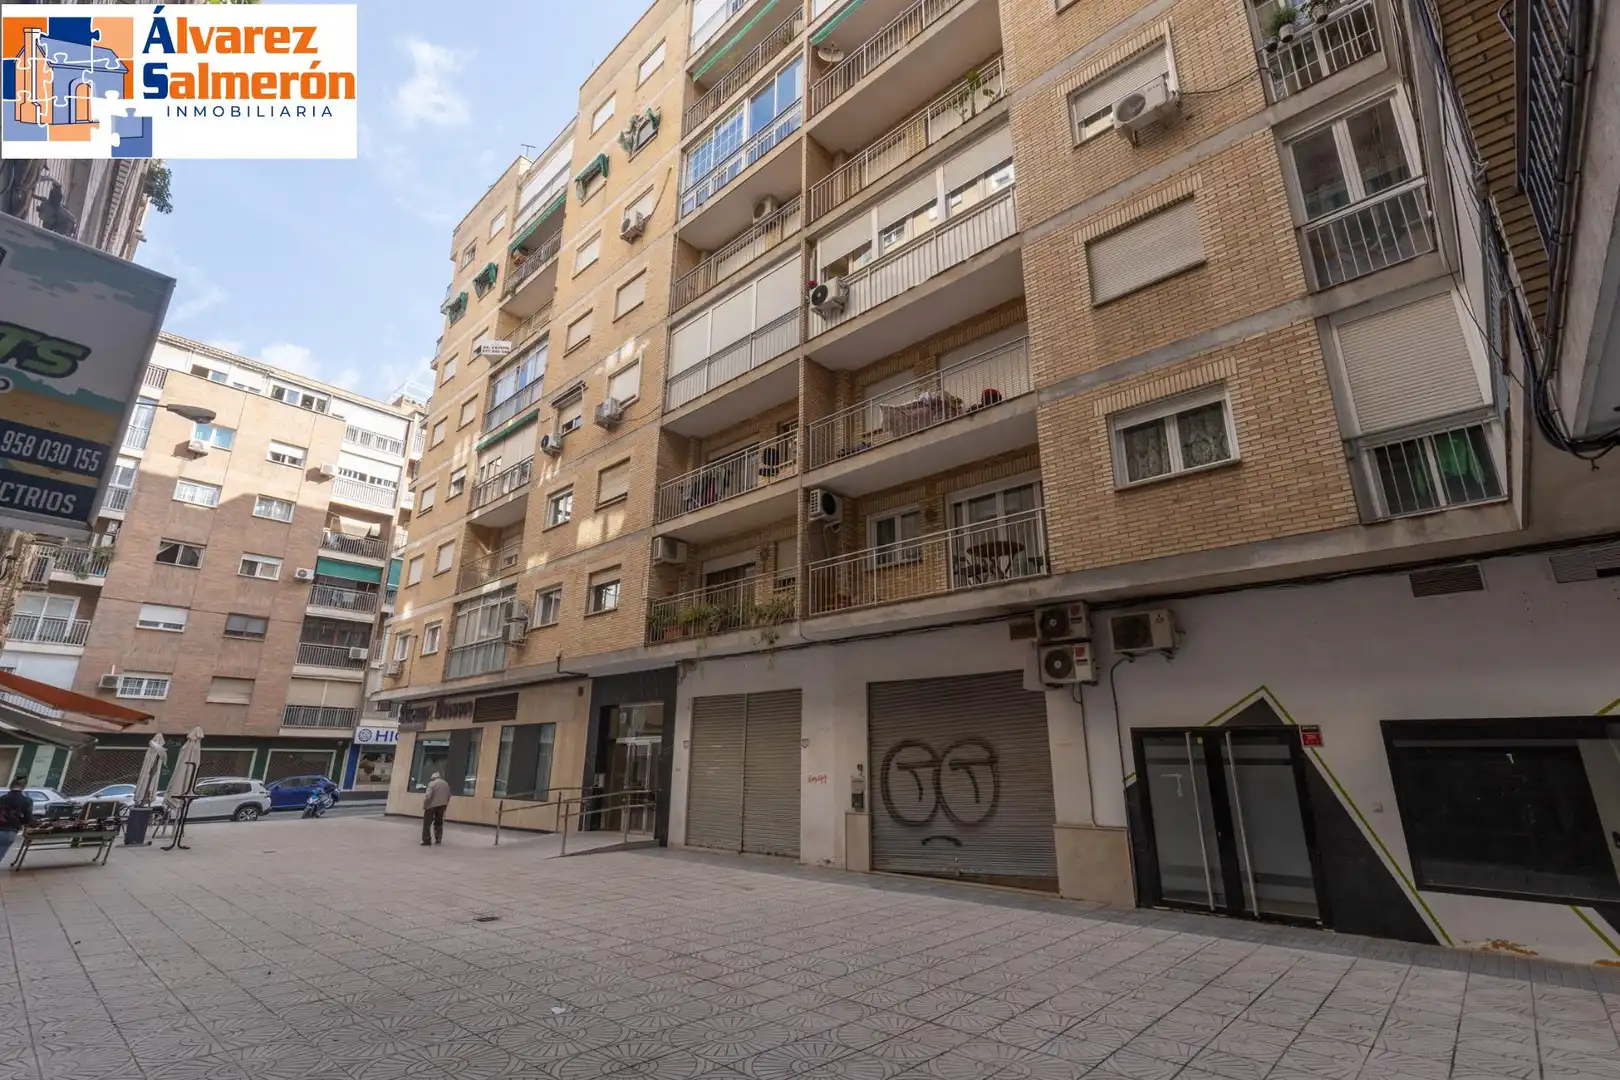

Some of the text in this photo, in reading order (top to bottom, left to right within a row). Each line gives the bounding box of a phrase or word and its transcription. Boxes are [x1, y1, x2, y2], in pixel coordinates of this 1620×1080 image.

[1, 430, 102, 472] 958 030 155
[0, 480, 77, 514] CTRIOS
